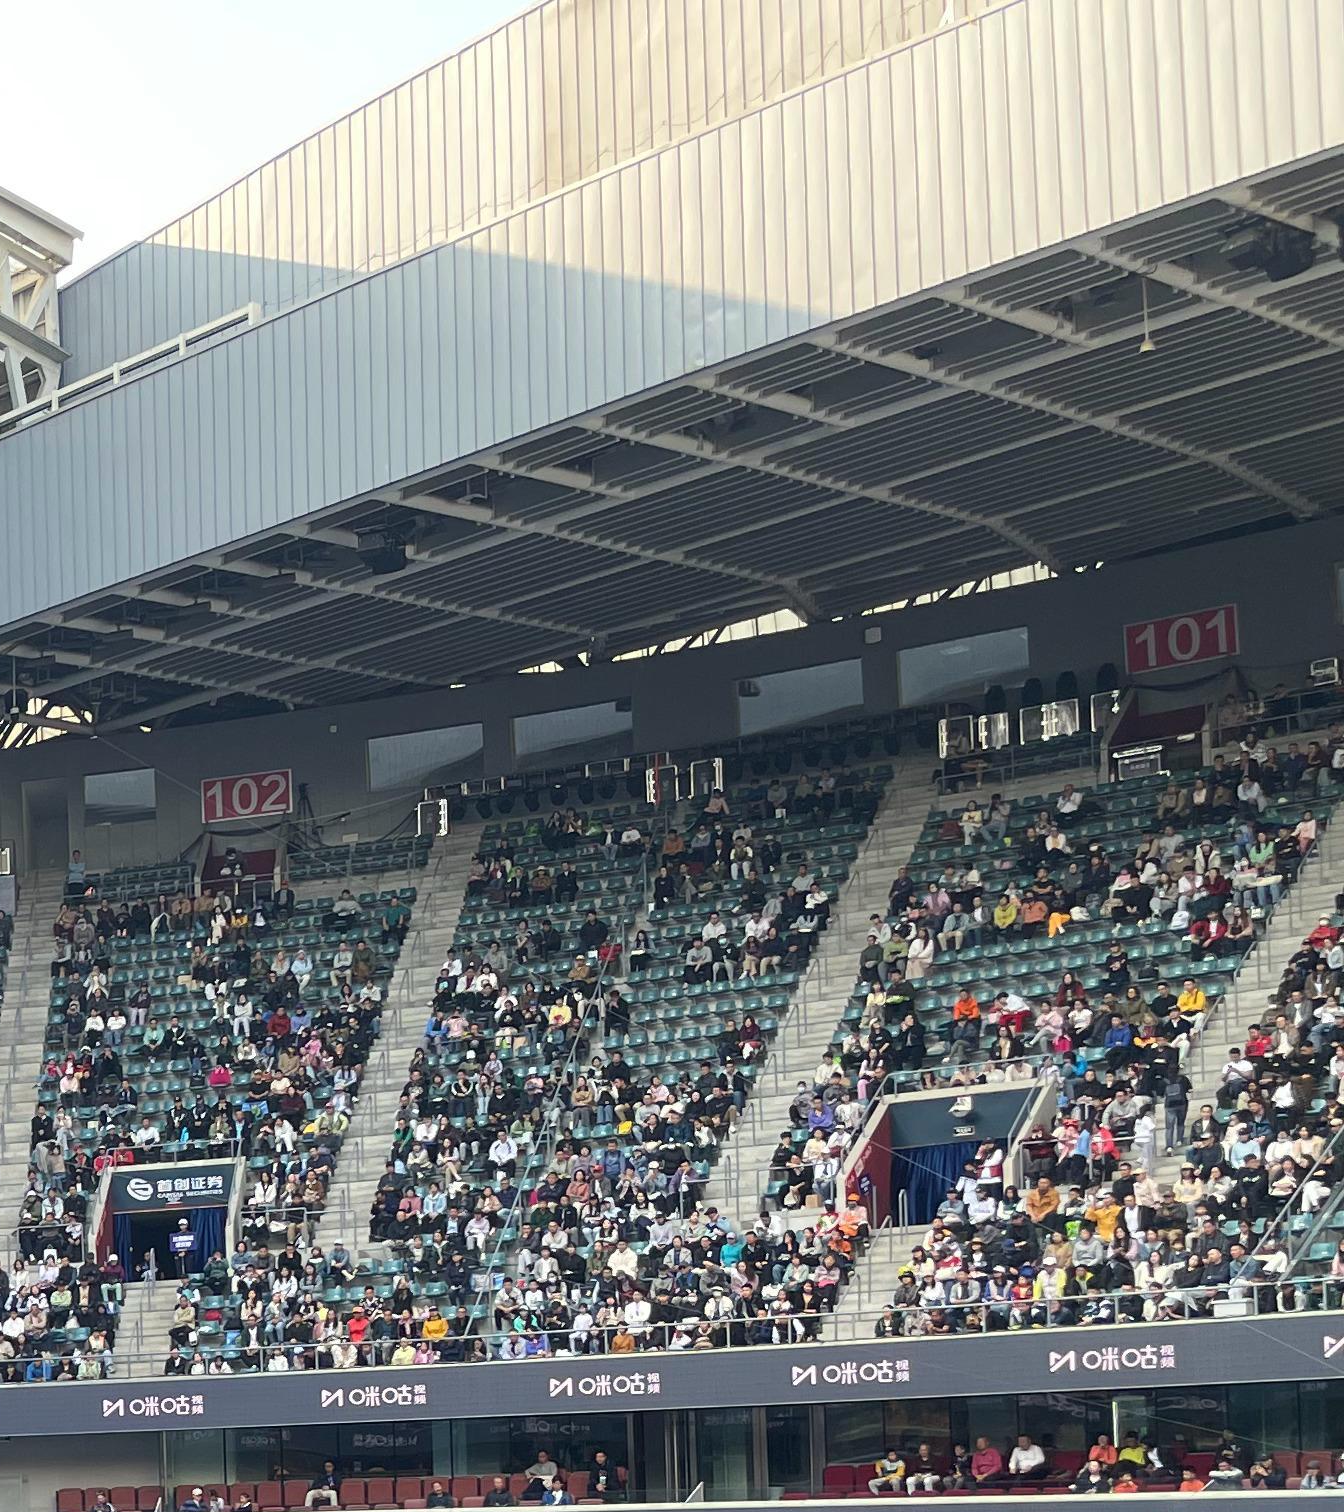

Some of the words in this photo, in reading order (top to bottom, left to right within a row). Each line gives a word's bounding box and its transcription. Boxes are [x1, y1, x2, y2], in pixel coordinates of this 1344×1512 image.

[1135, 608, 1229, 666] 101
[206, 775, 287, 817] 102
[156, 1175, 223, 1193] 首创证券
